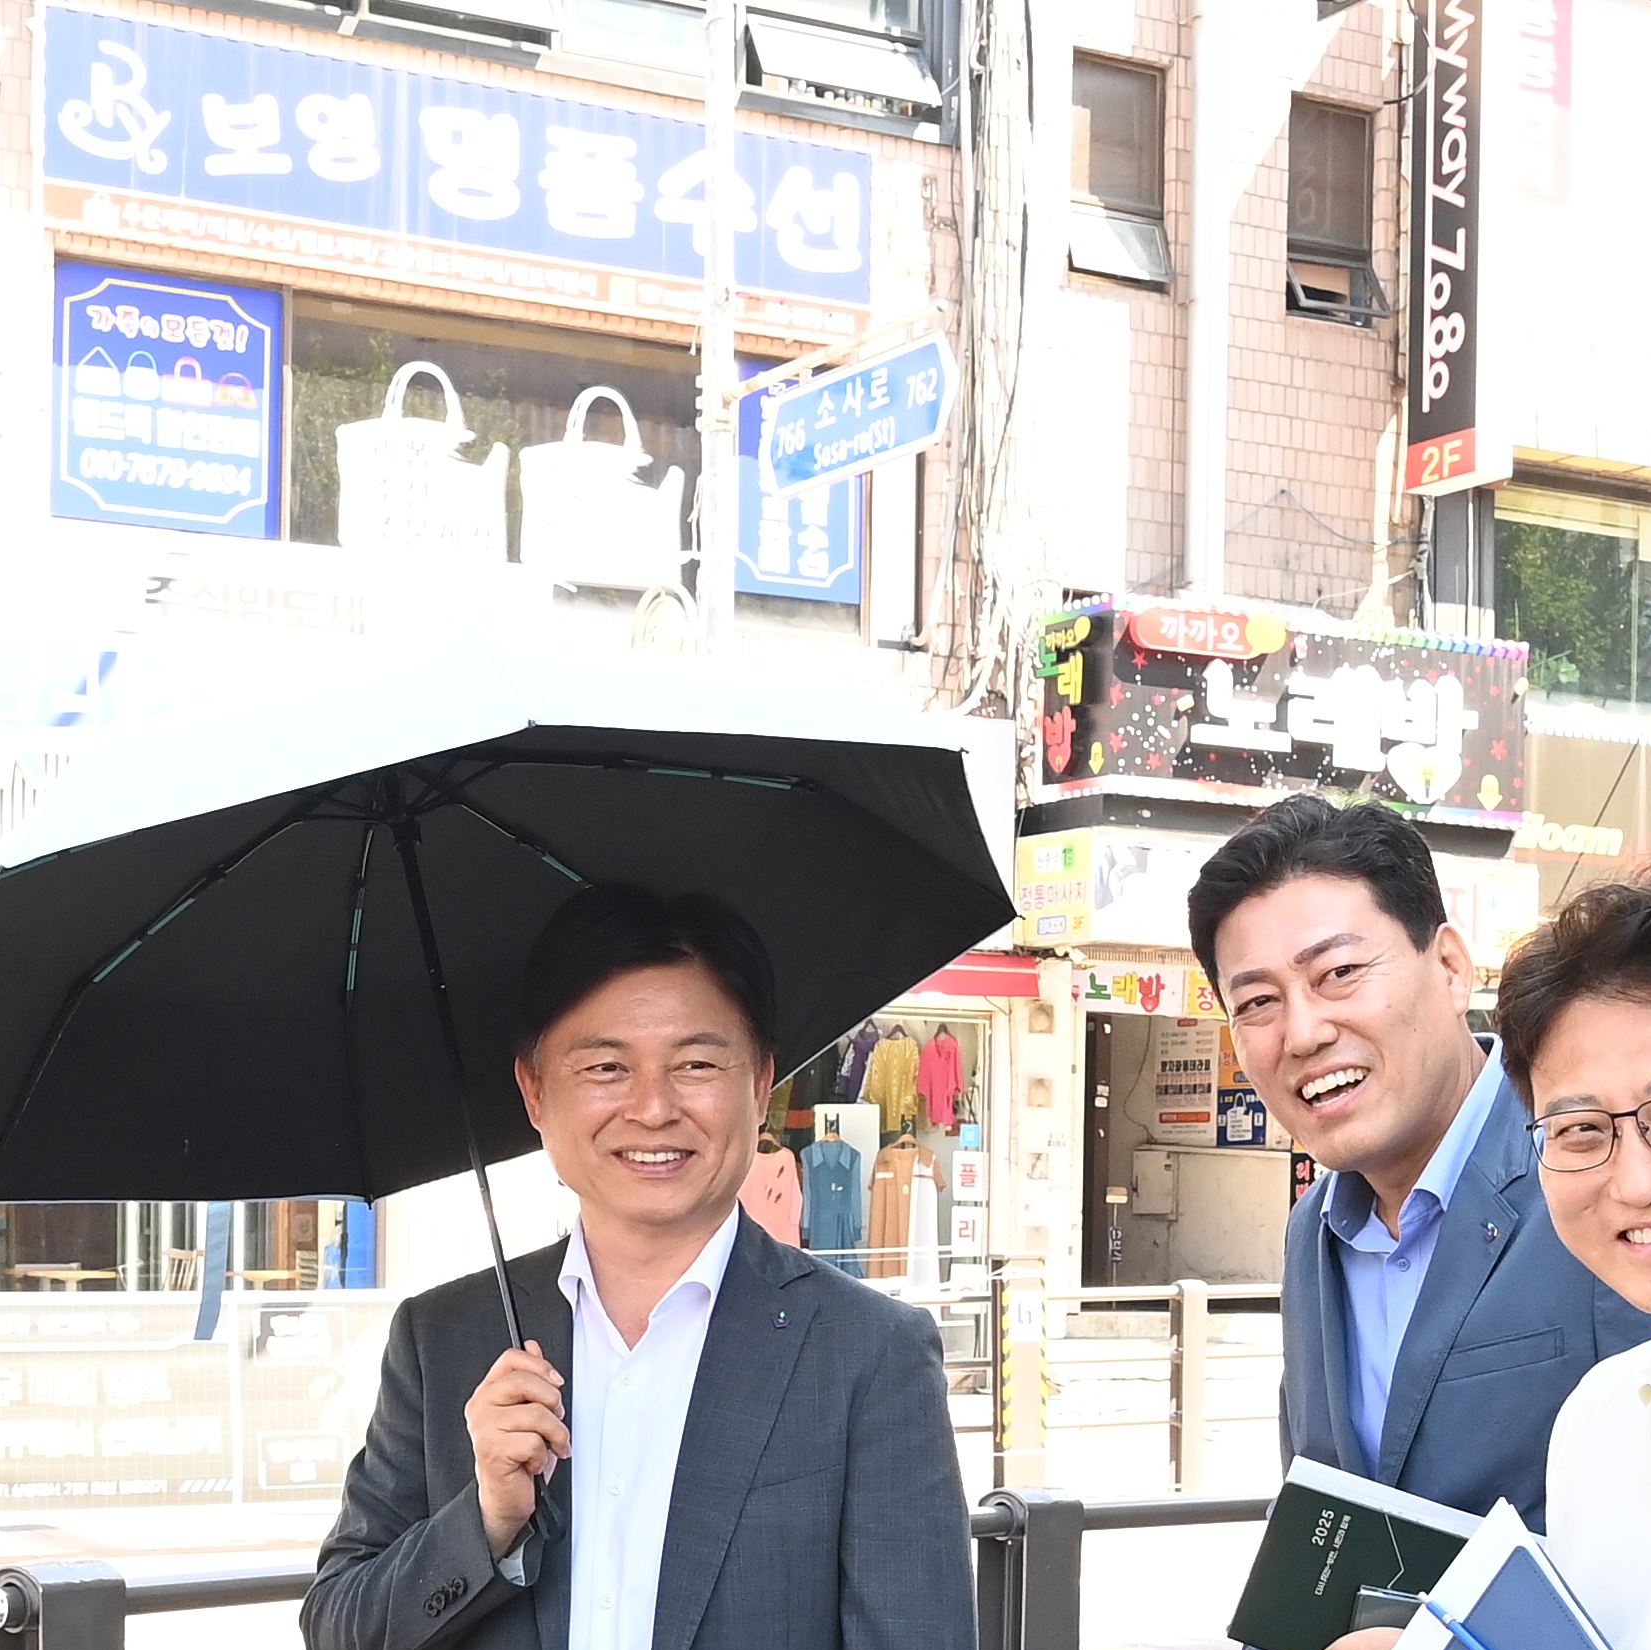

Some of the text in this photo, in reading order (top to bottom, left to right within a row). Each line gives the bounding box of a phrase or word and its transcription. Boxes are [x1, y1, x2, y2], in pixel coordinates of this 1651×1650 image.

[203, 92, 383, 182] 보영
[419, 103, 864, 276] 명품수선
[815, 367, 890, 430] 소사로
[906, 367, 938, 410] 762
[776, 419, 806, 459] 766
[813, 415, 896, 471] Sosa-ro(St)
[1422, 439, 1463, 485] 2F
[145, 575, 366, 635] 주식양도세
[1159, 613, 1245, 655] 까까오
[1190, 658, 1478, 806] 노래방
[1020, 881, 1086, 911] 정통마사지
[1085, 971, 1166, 1013] 노래방
[1310, 1508, 1335, 1546] 2025
